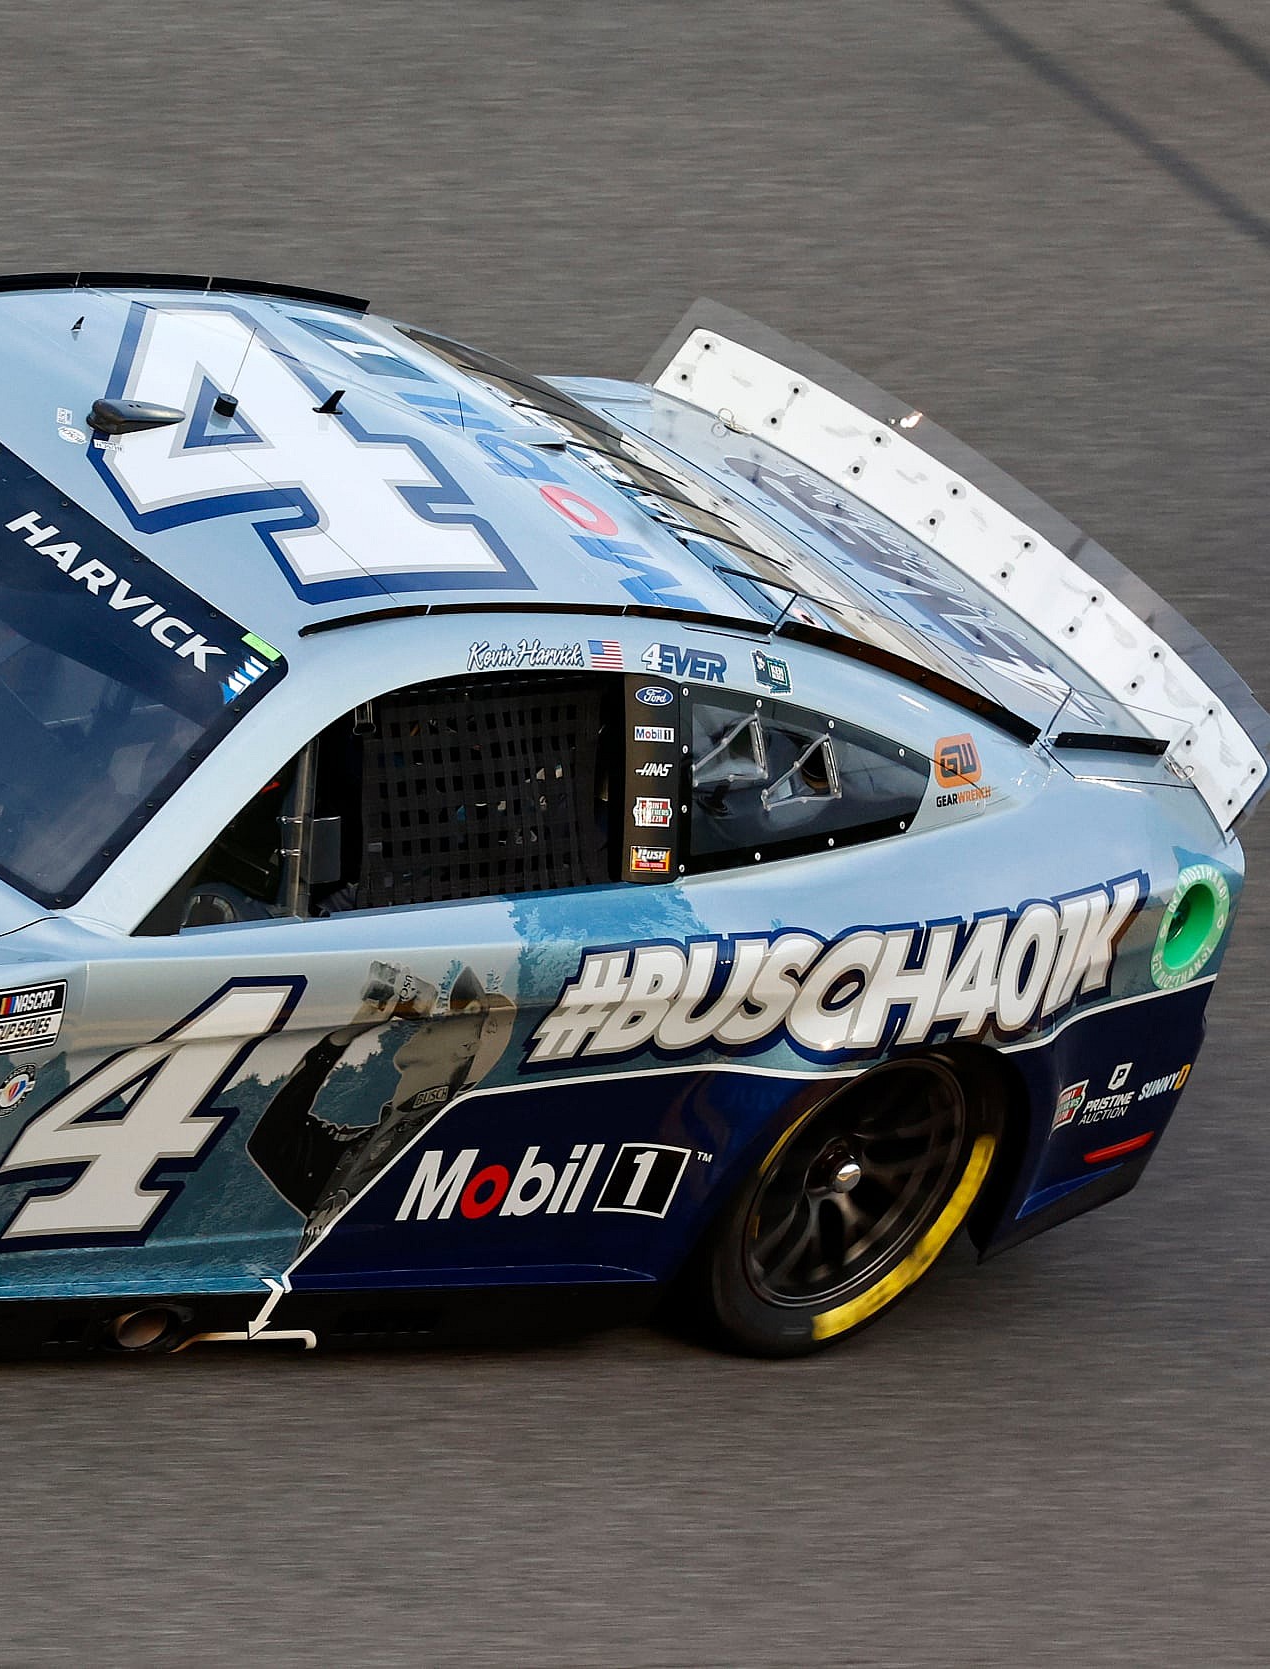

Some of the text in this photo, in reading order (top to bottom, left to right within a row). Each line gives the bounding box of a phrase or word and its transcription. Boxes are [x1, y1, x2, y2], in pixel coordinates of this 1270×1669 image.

[92, 302, 532, 603] 4
[394, 390, 710, 615] Mobil
[4, 510, 227, 674] HARVICK
[466, 638, 584, 671] Kevin Harvick
[640, 642, 728, 684] 4EVER
[643, 688, 668, 703] Ford
[635, 728, 662, 740] Mobil
[635, 762, 673, 777] HAAS
[935, 785, 992, 808] GEARWRENCH
[636, 848, 667, 862] RUSH
[522, 872, 1146, 1068] #BUSCH401K
[13, 989, 56, 1014] NASCAR
[14, 1017, 52, 1038] SERIES
[416, 1086, 449, 1106] BUSCH
[1082, 1090, 1136, 1114] PRISTINE
[1077, 1105, 1129, 1126] AUCTION
[394, 1143, 606, 1221] Mobil
